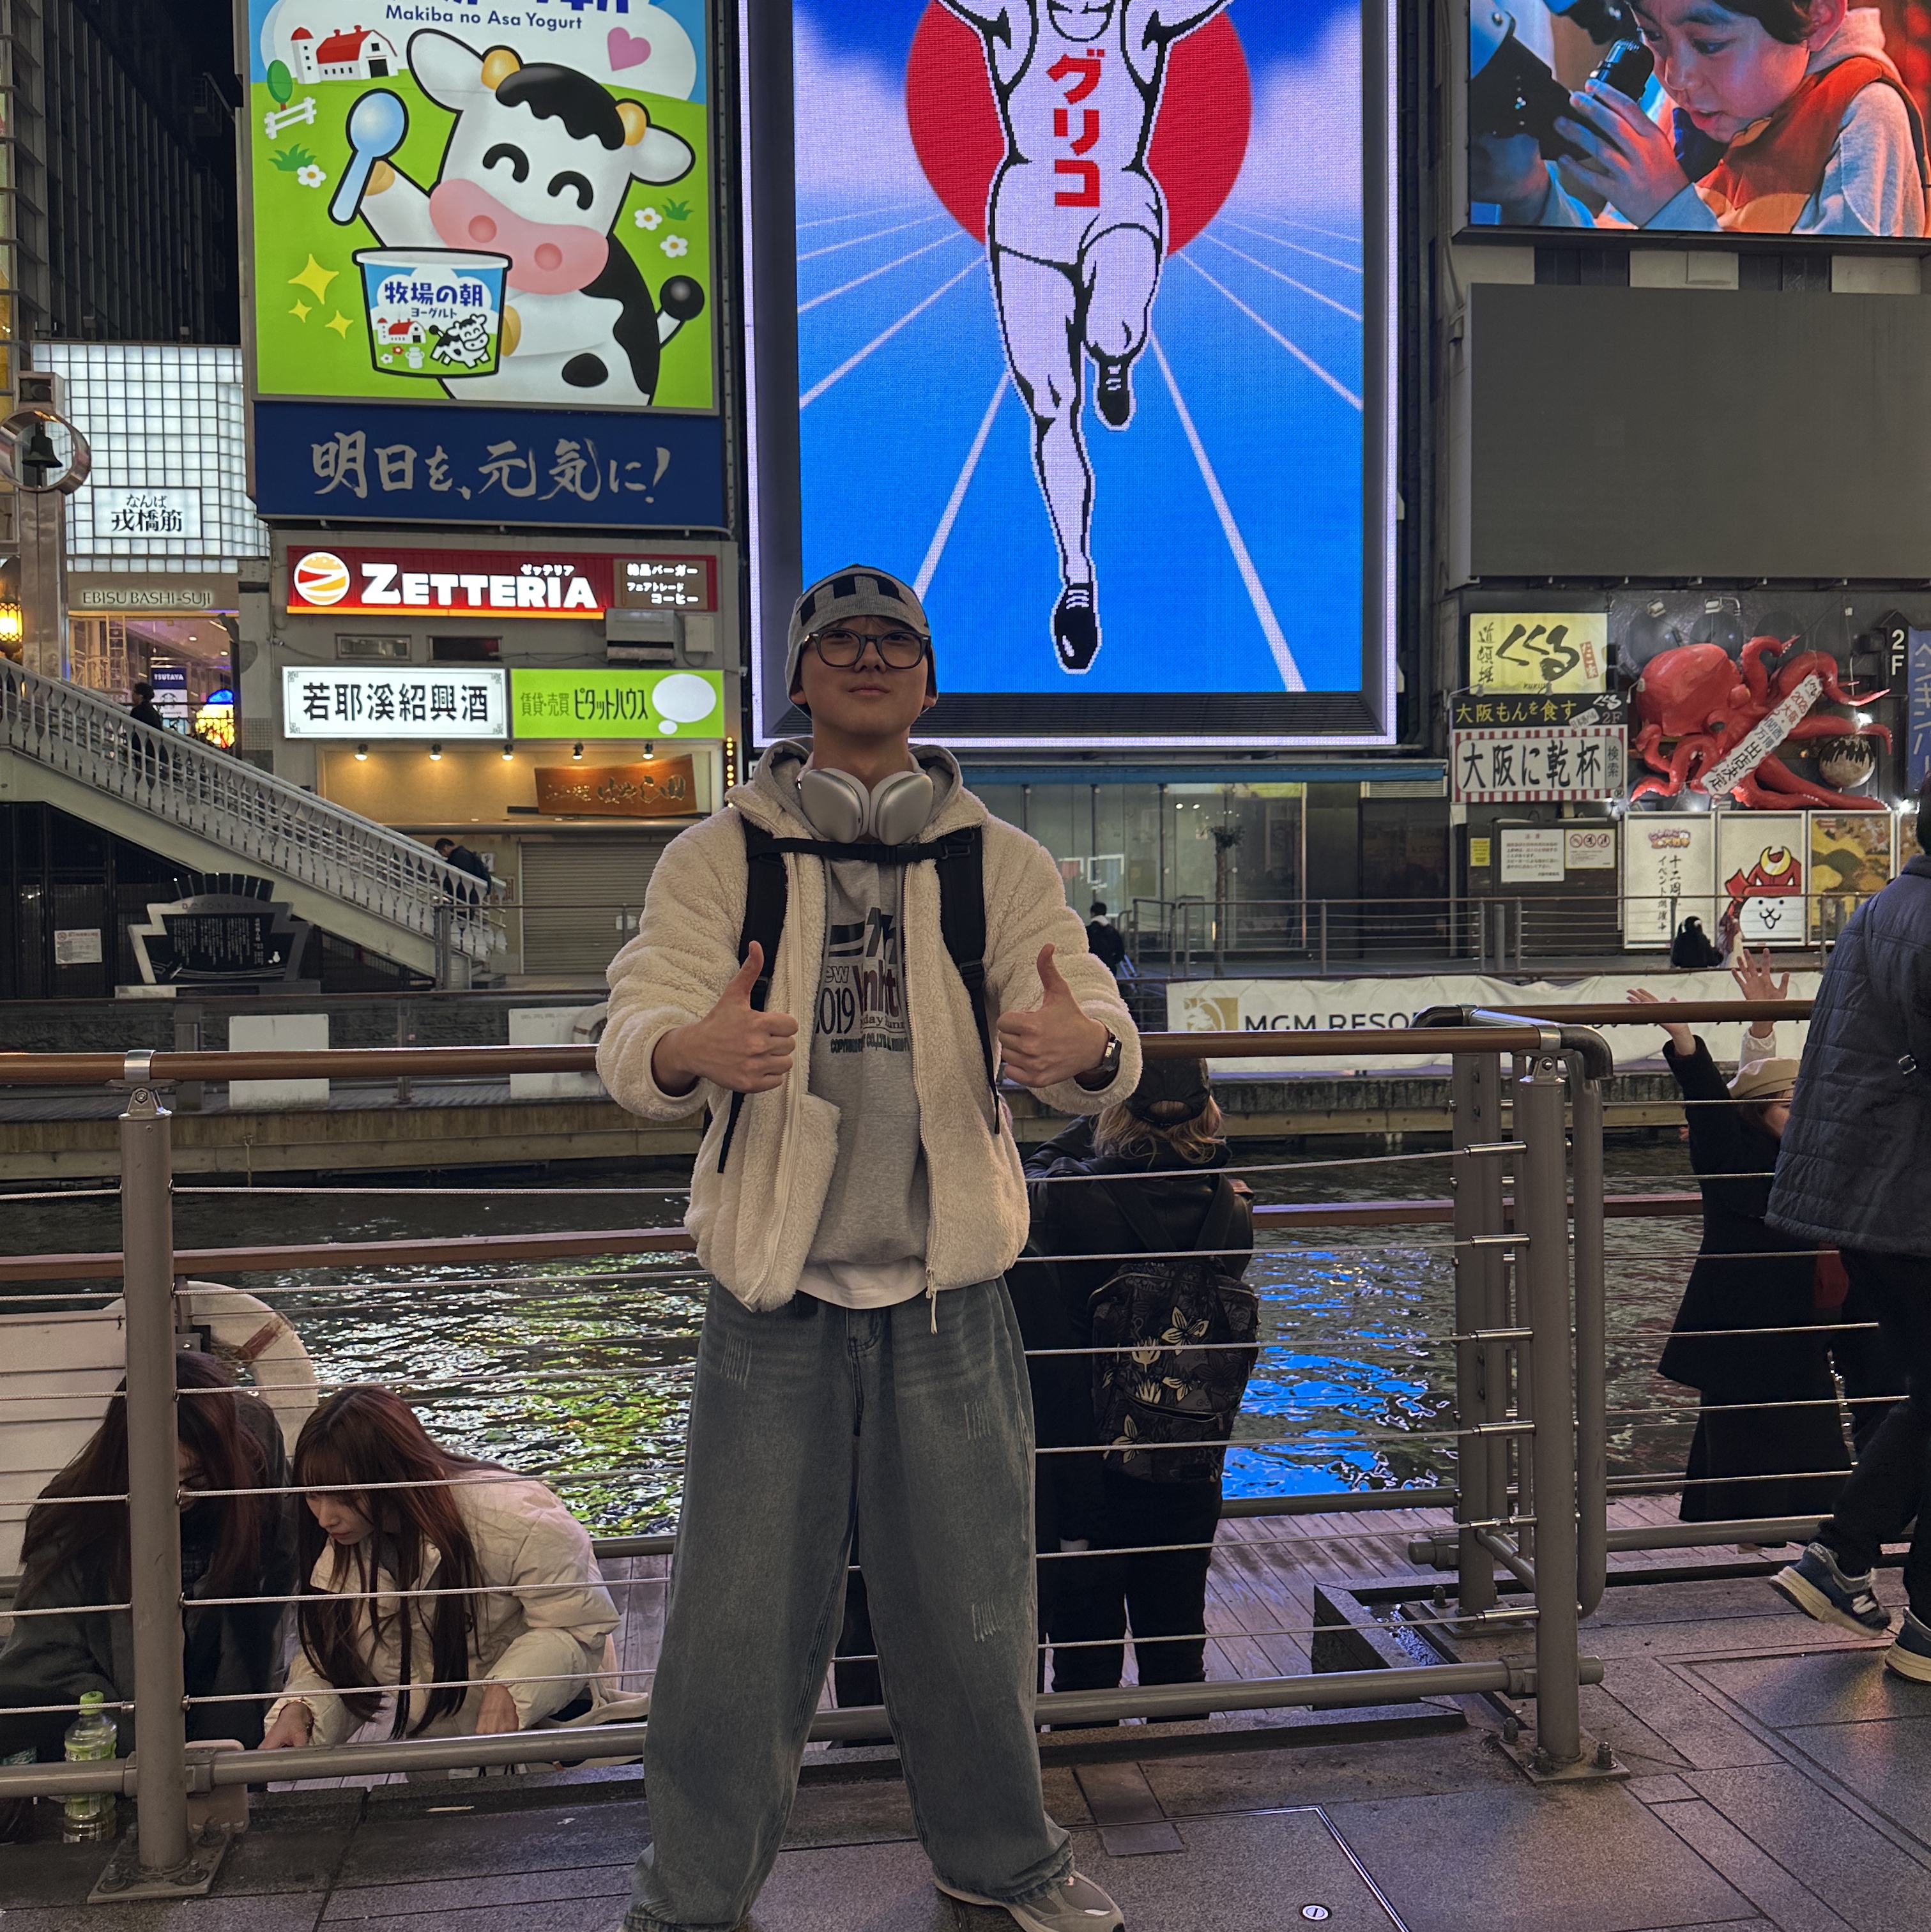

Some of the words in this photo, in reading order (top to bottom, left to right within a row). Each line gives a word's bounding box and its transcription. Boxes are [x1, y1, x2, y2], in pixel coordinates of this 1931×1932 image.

[386, 4, 453, 22] Makiba
[460, 13, 480, 24] no
[487, 10, 521, 26] Asa
[526, 12, 583, 31] Yogurt
[1046, 49, 1105, 207] グリコ
[385, 281, 483, 307] 牧場の朝
[411, 307, 457, 319] ヨーグルト
[126, 494, 167, 508] なんば
[111, 508, 183, 532] 戎橋筋
[521, 563, 575, 577] ゼッテリア
[362, 563, 598, 609] ZETTERIA
[627, 582, 685, 592] フェアトレード
[83, 591, 126, 605] EBISU
[131, 591, 211, 607] BASHI-SUJI
[651, 593, 699, 605] コーヒー
[1495, 624, 1580, 681] くくる
[1891, 629, 1905, 676] 2F
[521, 692, 570, 717] 賃貸・売買
[574, 687, 648, 721] ピタットハウス
[1455, 699, 1577, 724] 大阪もんを食す
[1592, 694, 1622, 710] くくる
[1790, 691, 1808, 715] 2025
[1602, 711, 1622, 724] 2F
[1463, 739, 1601, 789] 大阪に乾杯
[1607, 746, 1619, 778] 検索
[1709, 742, 1762, 792] 出店決定
[824, 965, 850, 984] ew
[1245, 1015, 1317, 1030] MGM
[1329, 1012, 1418, 1030] RESO
